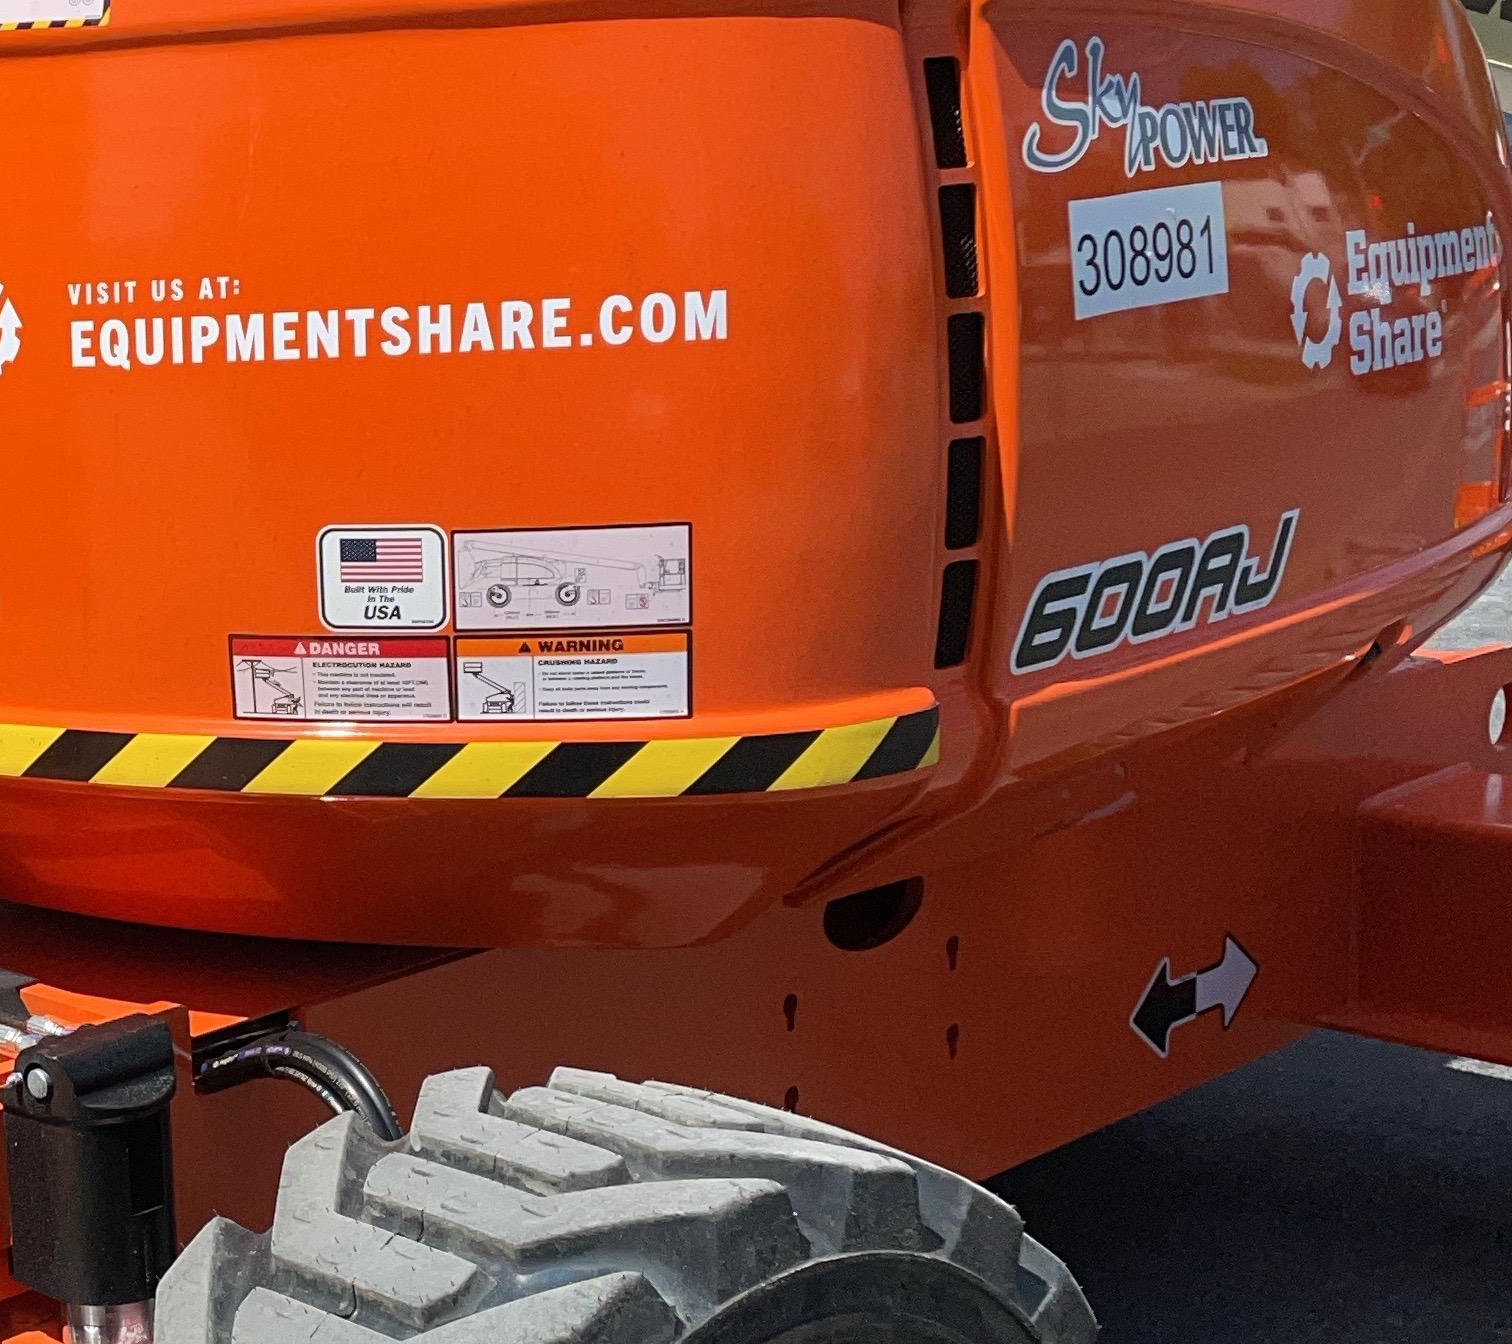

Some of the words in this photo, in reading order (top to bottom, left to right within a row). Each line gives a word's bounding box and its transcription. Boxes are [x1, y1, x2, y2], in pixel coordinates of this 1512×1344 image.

[1022, 35, 1142, 179] Sky
[1136, 99, 1263, 170] POWER
[68, 281, 138, 306] VISIT
[150, 278, 185, 302] US
[198, 275, 242, 301] AT:
[1076, 215, 1216, 298] 308981
[1345, 213, 1500, 299] Equipment
[69, 288, 730, 370] EQUIPMENTSHARE.COM
[1349, 309, 1444, 376] Share
[363, 604, 402, 620] USA
[368, 585, 388, 594] With
[391, 585, 415, 594] Pride
[1010, 508, 1301, 675] 600AJ
[309, 642, 381, 656] DANGER
[538, 639, 625, 653] WARNING
